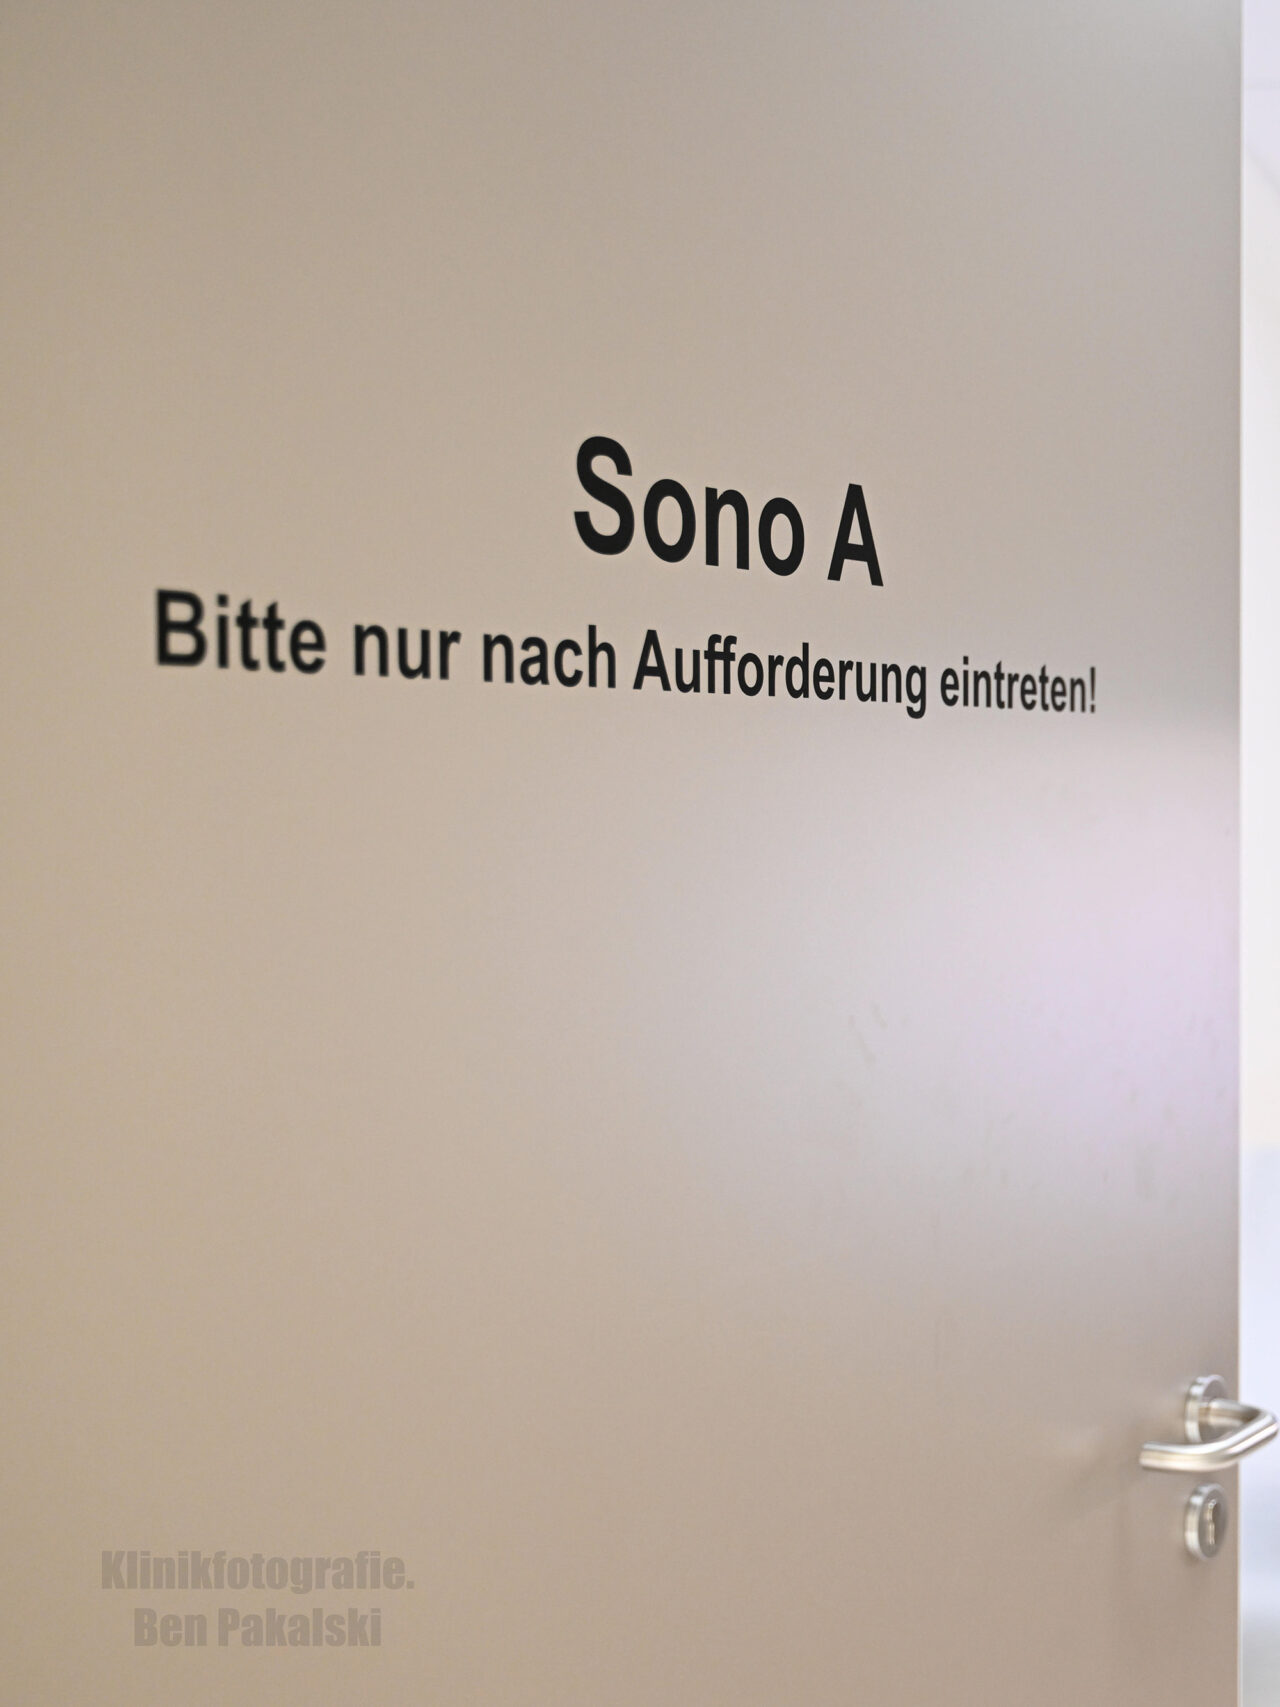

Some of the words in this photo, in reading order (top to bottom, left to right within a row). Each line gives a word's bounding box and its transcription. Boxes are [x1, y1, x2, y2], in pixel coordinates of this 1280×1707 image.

[573, 435, 805, 577] Sono
[827, 483, 884, 587] A
[156, 588, 326, 675] Bitte
[354, 624, 462, 680] nur
[483, 624, 616, 689] nach
[632, 629, 928, 720] Aufforderung
[939, 655, 1097, 713] eintreten!
